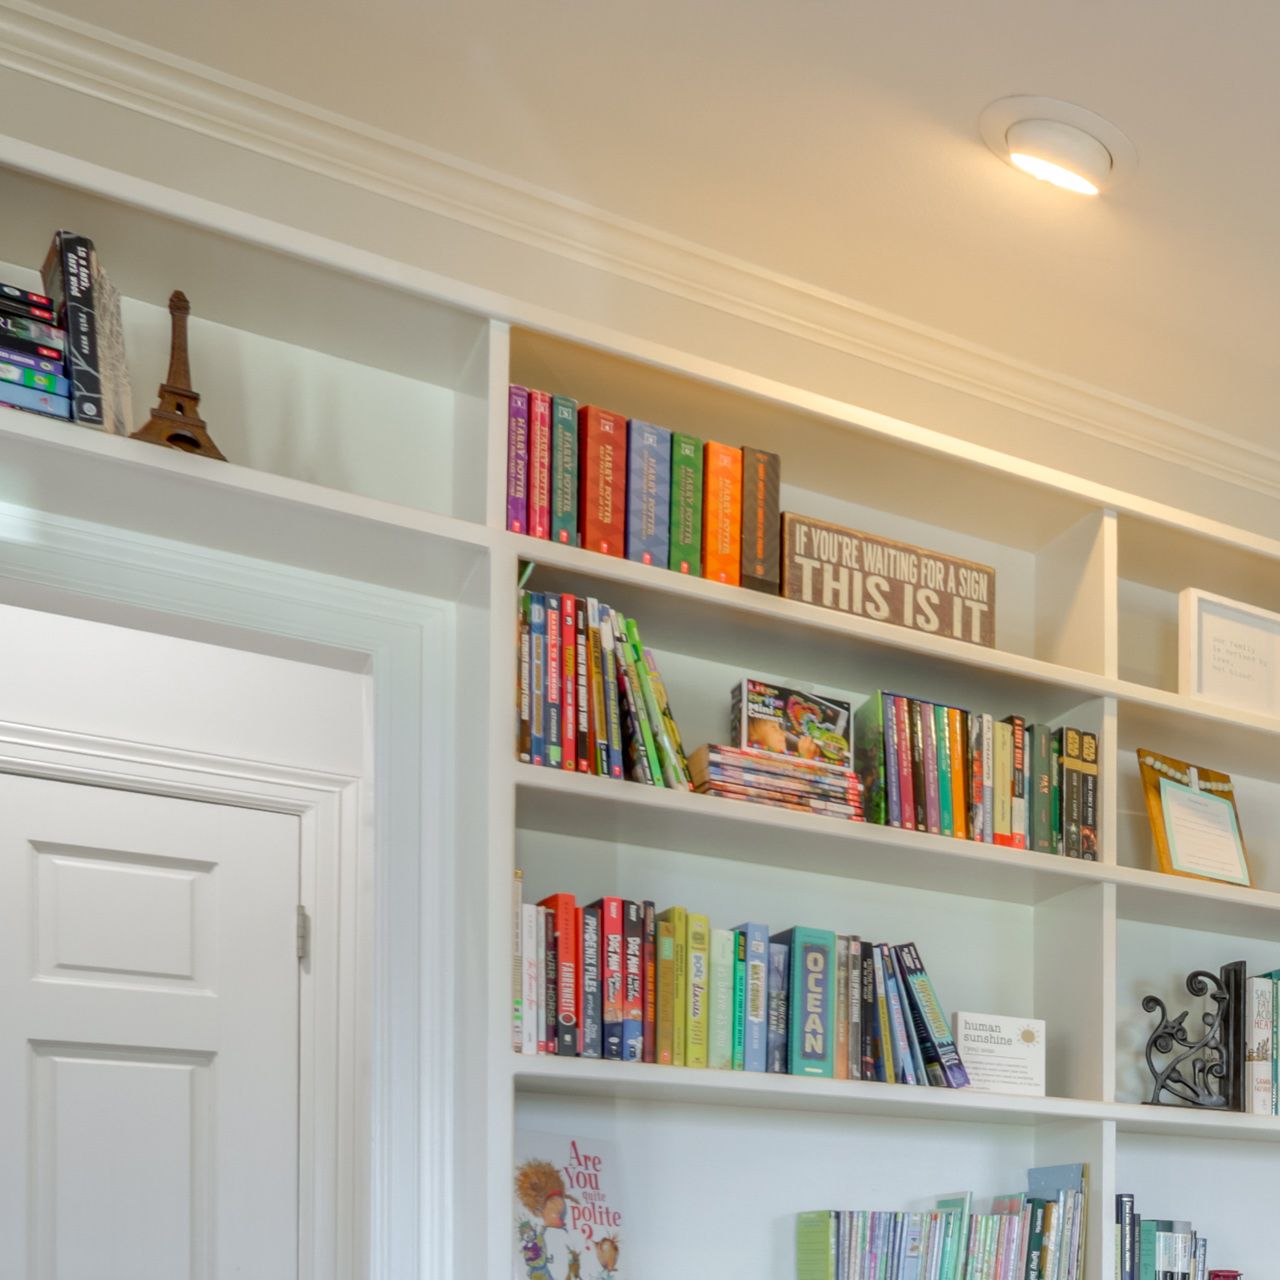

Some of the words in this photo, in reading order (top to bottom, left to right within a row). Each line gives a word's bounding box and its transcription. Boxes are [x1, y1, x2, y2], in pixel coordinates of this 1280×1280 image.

[516, 417, 526, 457] HARRY
[539, 426, 549, 465] HARRY
[563, 431, 573, 471] HARRY
[604, 444, 613, 482] HARRY
[647, 457, 656, 496] HARRY
[516, 460, 526, 498] POTTER
[539, 467, 549, 508] POTTER
[563, 473, 573, 512] POTTER
[685, 468, 694, 505] HARRY
[604, 485, 613, 524] POTTER
[647, 498, 656, 536] POTTER
[685, 507, 694, 545] POTTER
[795, 523, 809, 555] IF
[811, 527, 860, 569] YOU'RE
[863, 541, 917, 584] WAITING
[920, 558, 945, 591] FOR
[947, 565, 957, 595] A
[958, 568, 988, 602] SIGN
[795, 555, 890, 620] THIS
[903, 584, 940, 632] IS
[952, 596, 989, 643] IT
[550, 612, 558, 646] MANUAL
[577, 634, 586, 644] THE
[551, 647, 558, 658] TO
[577, 644, 587, 664] BATTLE
[550, 660, 558, 700] MANHOOD
[1015, 726, 1023, 748] LUCKY
[1015, 748, 1023, 769] CHILD
[1039, 774, 1049, 794] PAX
[608, 934, 622, 953] DOG
[627, 936, 640, 955] DOG
[546, 949, 555, 979] WAR
[608, 953, 621, 971] MAN
[627, 955, 640, 975] MAN
[693, 954, 704, 980] DORK
[561, 961, 576, 1011] FAHRENHEIT
[585, 965, 597, 993] FILES
[1254, 989, 1272, 999] SALT
[547, 983, 556, 1026] HORSE
[691, 983, 704, 1018] diaries
[804, 952, 825, 1054] OCEAN
[1257, 1000, 1271, 1010] FAT
[770, 1010, 778, 1031] BARN
[778, 1000, 786, 1035] UNICORN
[963, 1020, 1002, 1033] human
[1254, 1020, 1273, 1030] HEAT
[963, 1033, 1013, 1046] sunshine
[568, 1140, 602, 1172] Are
[563, 1166, 600, 1190] You
[582, 1191, 606, 1205] quite
[570, 1202, 622, 1230] polite
[580, 1223, 593, 1251] ?
